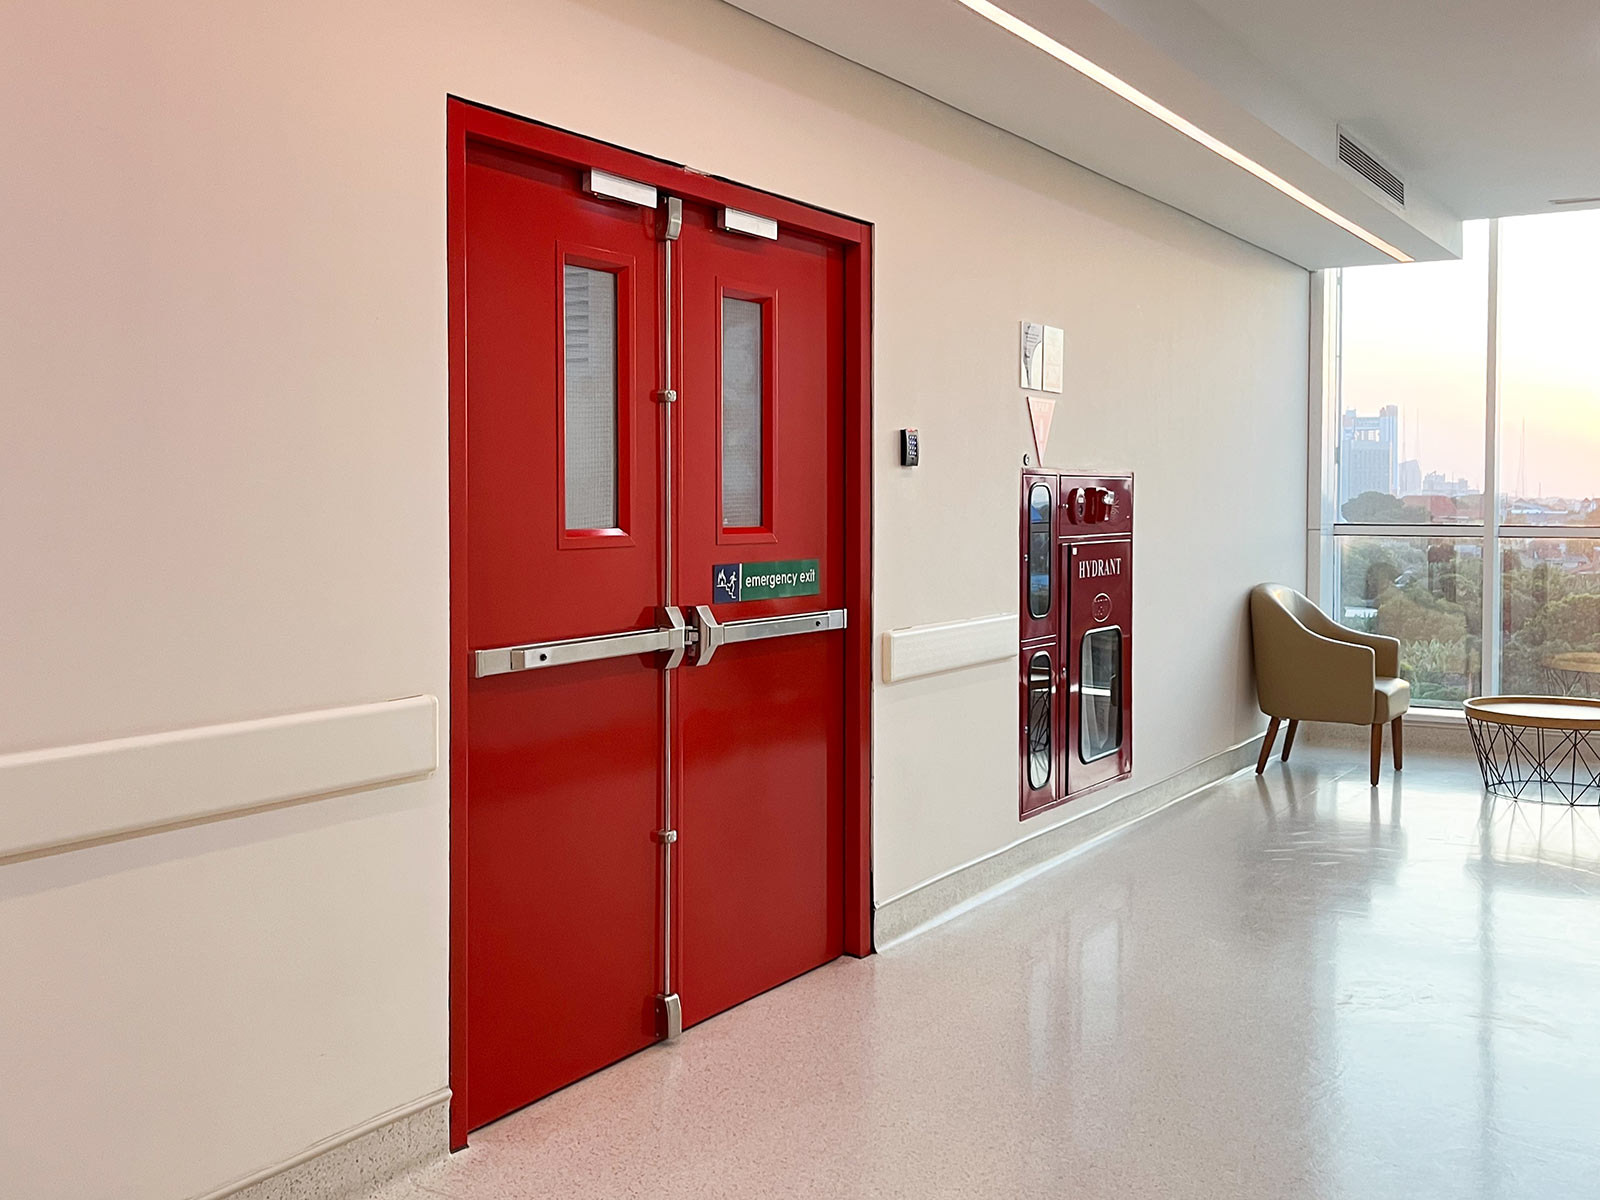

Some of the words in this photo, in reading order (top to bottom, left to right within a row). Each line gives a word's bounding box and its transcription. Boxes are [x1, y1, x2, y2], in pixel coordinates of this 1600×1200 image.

[1079, 558, 1121, 579] HYDRANT
[745, 572, 798, 589] emergency
[800, 569, 815, 583] exit
